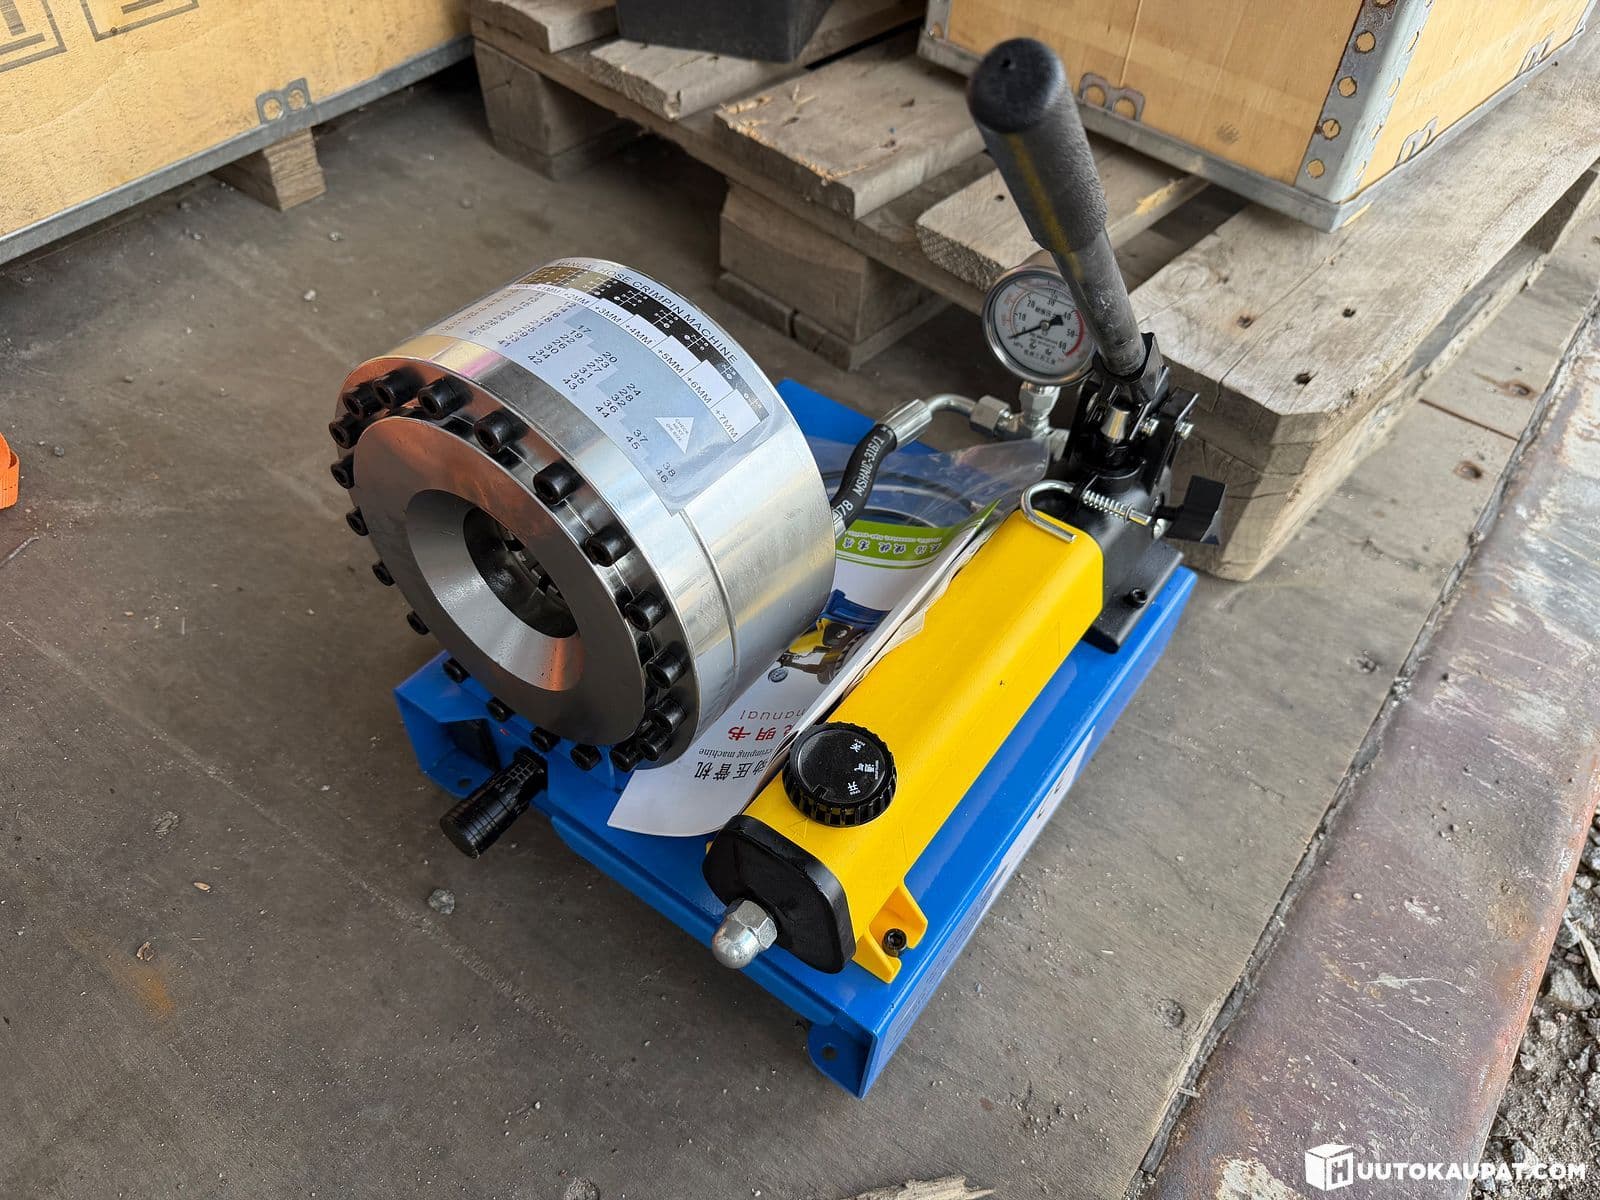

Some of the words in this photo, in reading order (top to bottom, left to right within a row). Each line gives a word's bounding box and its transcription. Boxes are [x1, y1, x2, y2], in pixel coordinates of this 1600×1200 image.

[578, 325, 592, 334] 17
[599, 267, 632, 283] HOSE
[632, 281, 684, 315] CRIMPIN
[684, 313, 738, 364] MACHINE
[1018, 312, 1026, 321] 10
[1027, 300, 1035, 308] 20
[1066, 329, 1075, 338] 50
[544, 344, 559, 354] 30
[579, 367, 593, 378] 31
[611, 394, 626, 407] 32
[552, 339, 567, 349] 26
[586, 361, 602, 373] 27
[618, 388, 634, 402] 28
[560, 334, 576, 344] 22
[594, 356, 610, 369] 23
[626, 383, 641, 396] 24
[570, 330, 583, 339] 19
[602, 351, 618, 363] 20
[595, 306, 622, 323] +3MM
[625, 323, 652, 345] +4MM
[658, 349, 684, 374] +5MM
[687, 376, 712, 404] +6MM
[716, 409, 738, 438] +7MM
[528, 354, 543, 365] 42
[562, 378, 578, 390] 43
[595, 405, 610, 418] 44
[625, 435, 640, 449] 45
[656, 468, 668, 483] 46
[536, 349, 551, 359] 34
[570, 372, 586, 384] 35
[603, 399, 618, 413] 36
[633, 429, 648, 442] 37
[663, 462, 676, 477] 38
[698, 748, 735, 759] machine
